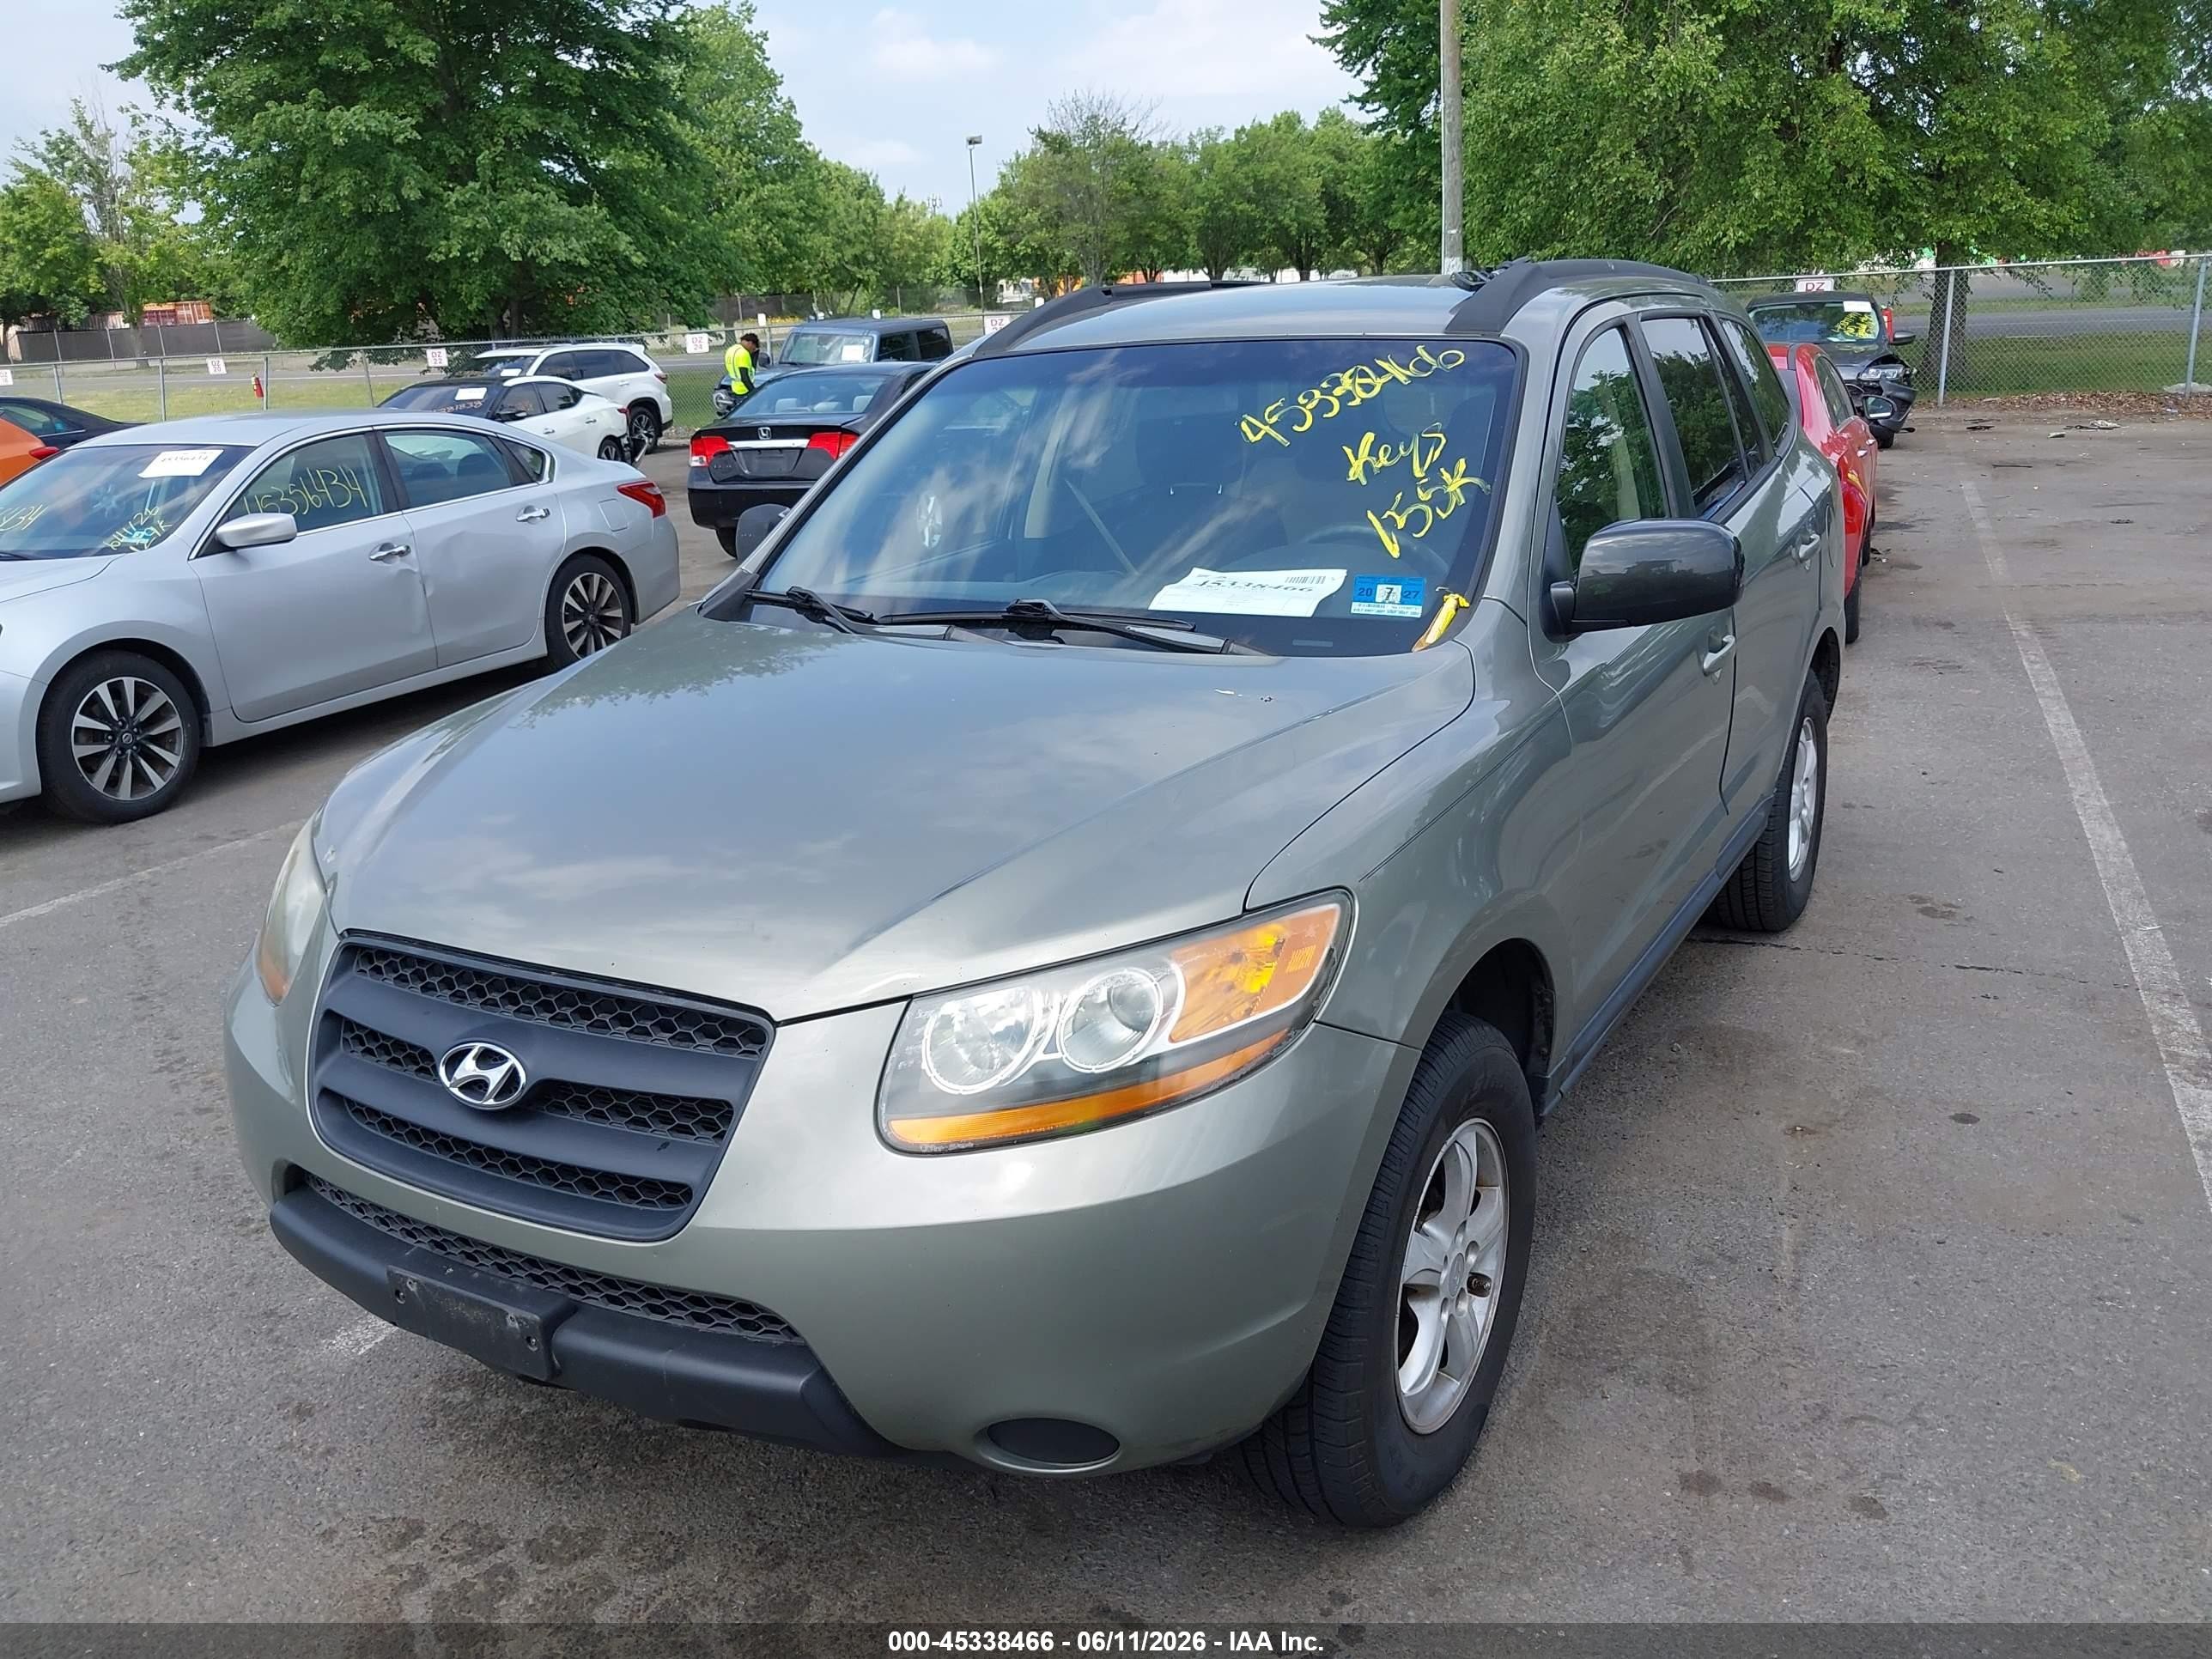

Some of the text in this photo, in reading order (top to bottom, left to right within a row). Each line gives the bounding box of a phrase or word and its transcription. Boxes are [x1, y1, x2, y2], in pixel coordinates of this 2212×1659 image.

[1805, 282, 1826, 292] DZ
[990, 319, 1004, 327] DZ
[691, 336, 704, 344] DZ
[1358, 586, 1420, 601] 20 7 27
